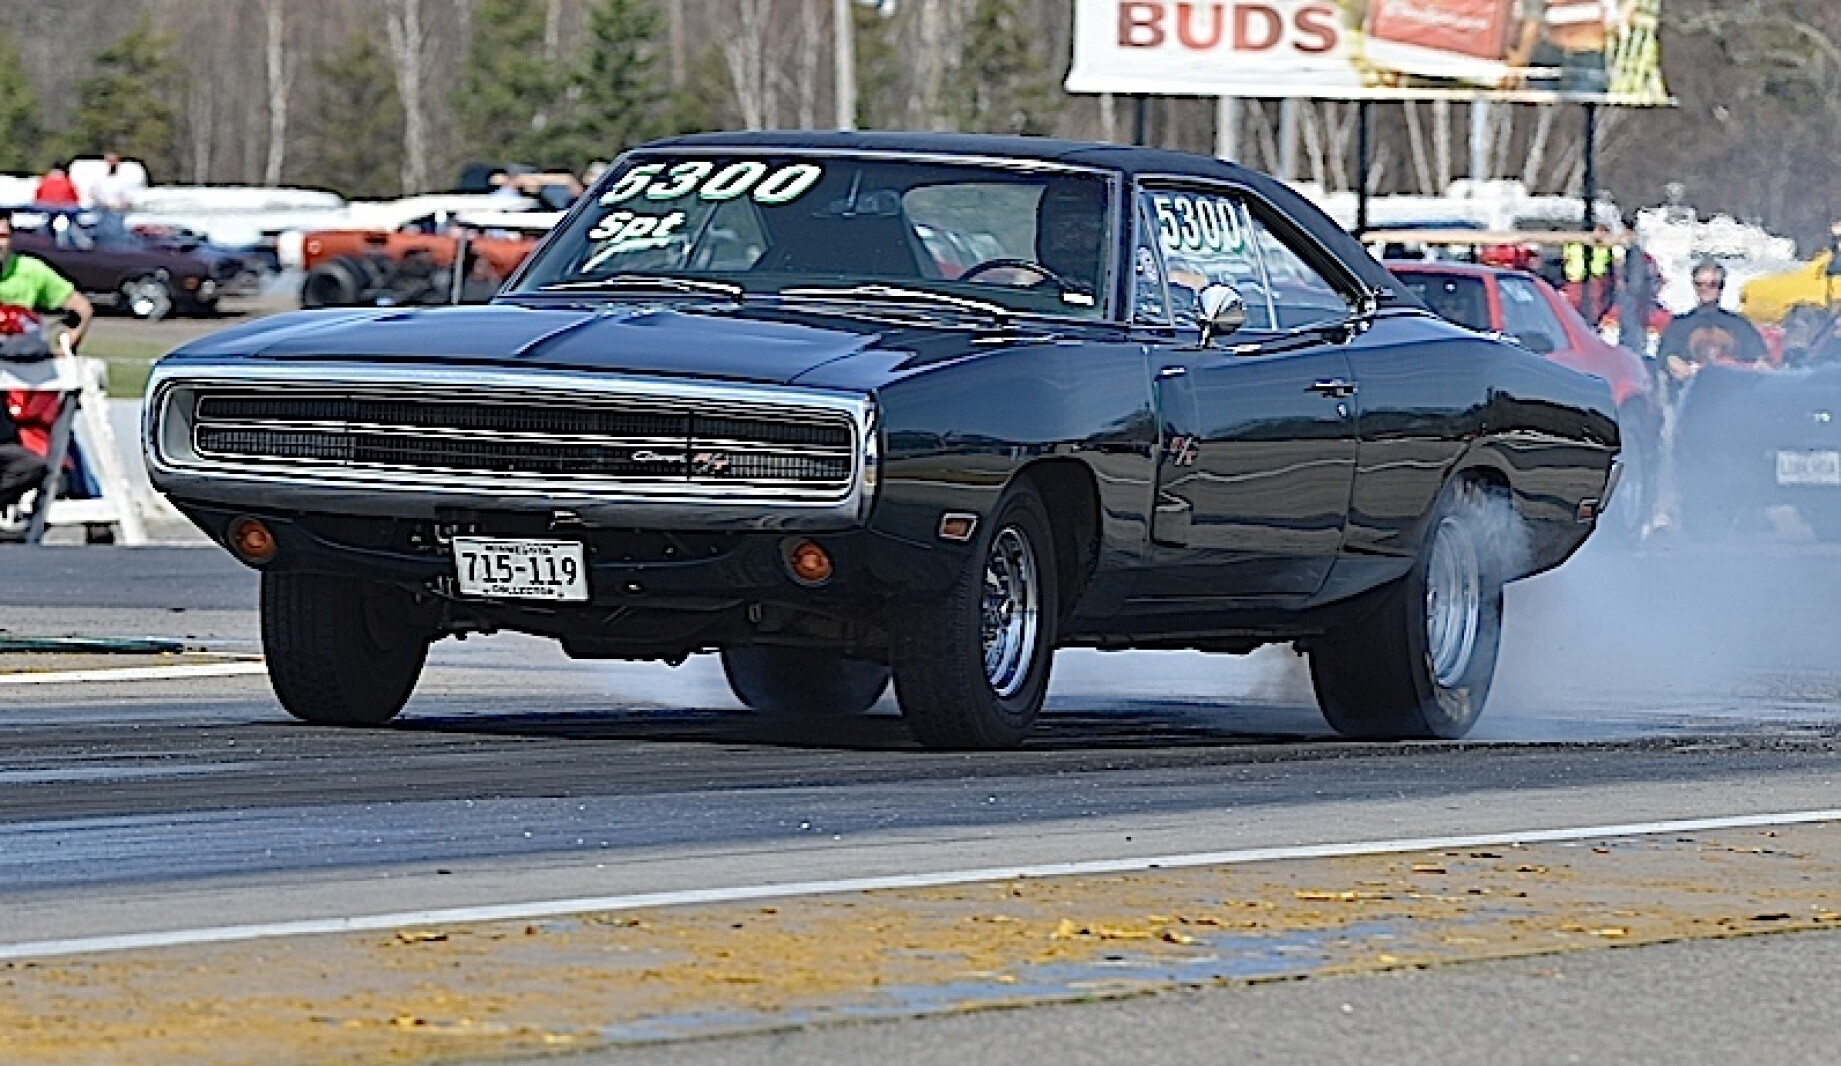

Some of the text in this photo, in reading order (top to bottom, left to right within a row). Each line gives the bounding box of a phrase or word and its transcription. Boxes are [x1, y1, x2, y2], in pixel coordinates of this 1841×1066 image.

[1117, 0, 1338, 52] BUDS
[599, 161, 822, 204] 5300
[1153, 196, 1245, 254] 5300
[462, 552, 577, 586] 715-119
